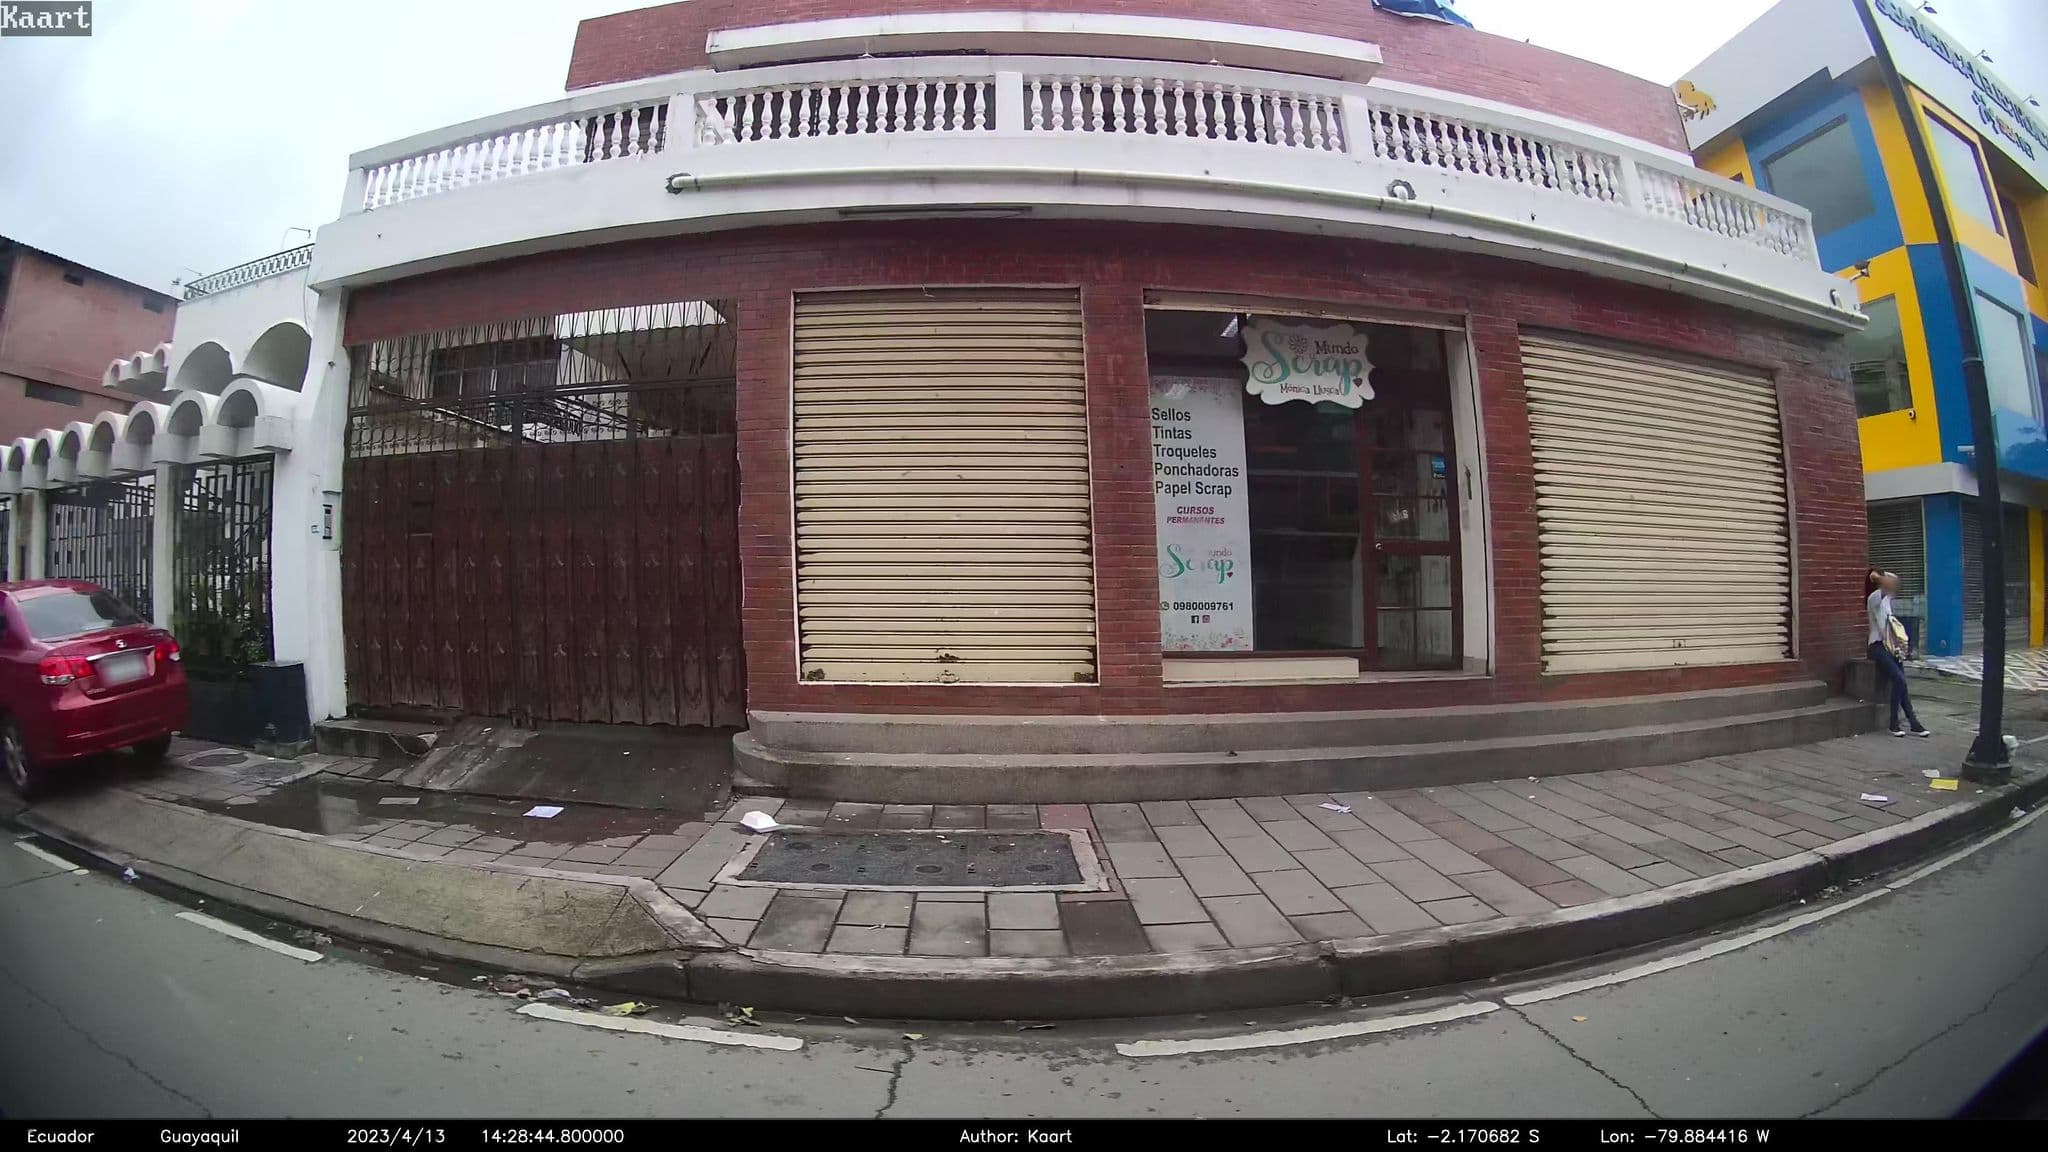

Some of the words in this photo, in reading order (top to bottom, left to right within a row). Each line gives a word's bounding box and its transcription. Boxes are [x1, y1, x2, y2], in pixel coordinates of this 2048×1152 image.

[1315, 340, 1359, 354] Mundo
[1252, 331, 1362, 396] Scrap
[1152, 408, 1191, 421] Sellos
[1152, 425, 1192, 439] Tintas
[1153, 444, 1217, 460] Troqueles
[1155, 462, 1239, 477] Ponchadoras
[1156, 481, 1191, 497] Papel
[1195, 482, 1232, 498] Scrap
[1177, 506, 1215, 515] CURSOS
[1173, 602, 1234, 611] 0980009761
